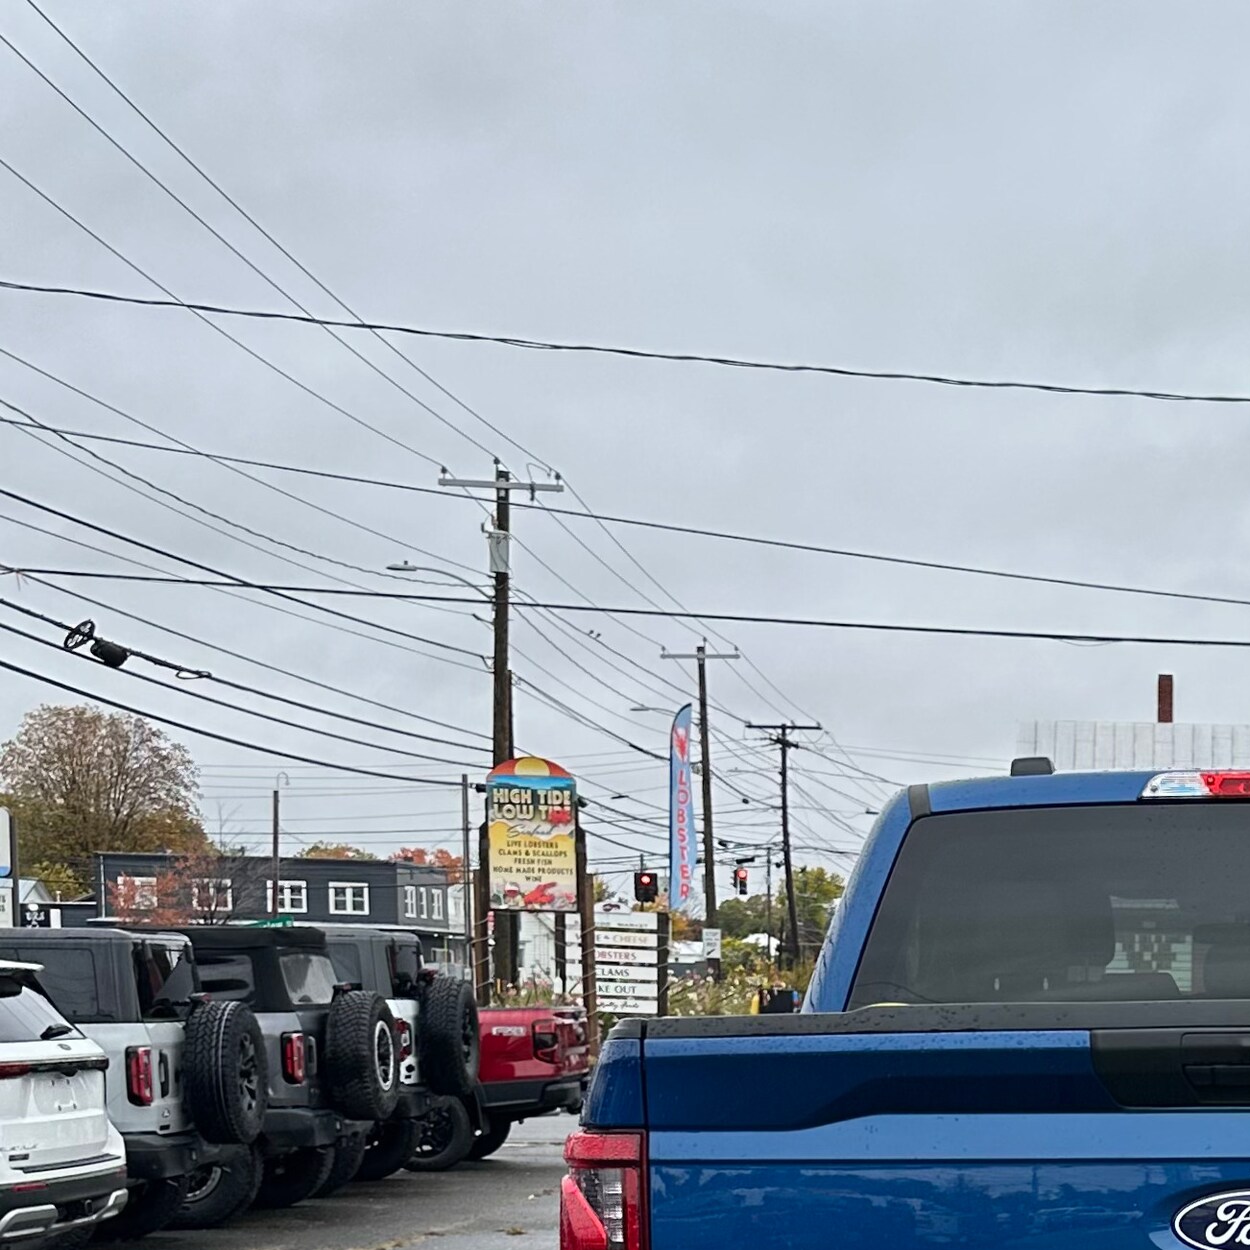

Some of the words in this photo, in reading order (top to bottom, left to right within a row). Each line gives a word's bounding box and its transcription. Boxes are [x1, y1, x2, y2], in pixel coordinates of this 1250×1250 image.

[493, 788, 532, 804] HIGH
[537, 790, 571, 805] TIDE
[493, 804, 534, 820] LOW
[676, 769, 693, 899] LOBSTER
[524, 841, 559, 849] LOBSTERS
[498, 849, 522, 857] CLAMS
[532, 850, 568, 858] SCALLOPS
[537, 858, 552, 866] FISH
[493, 866, 513, 874] HOME
[538, 867, 573, 876] PRODUCTS
[596, 951, 637, 960] OBSTERS
[614, 985, 637, 994] OUT
